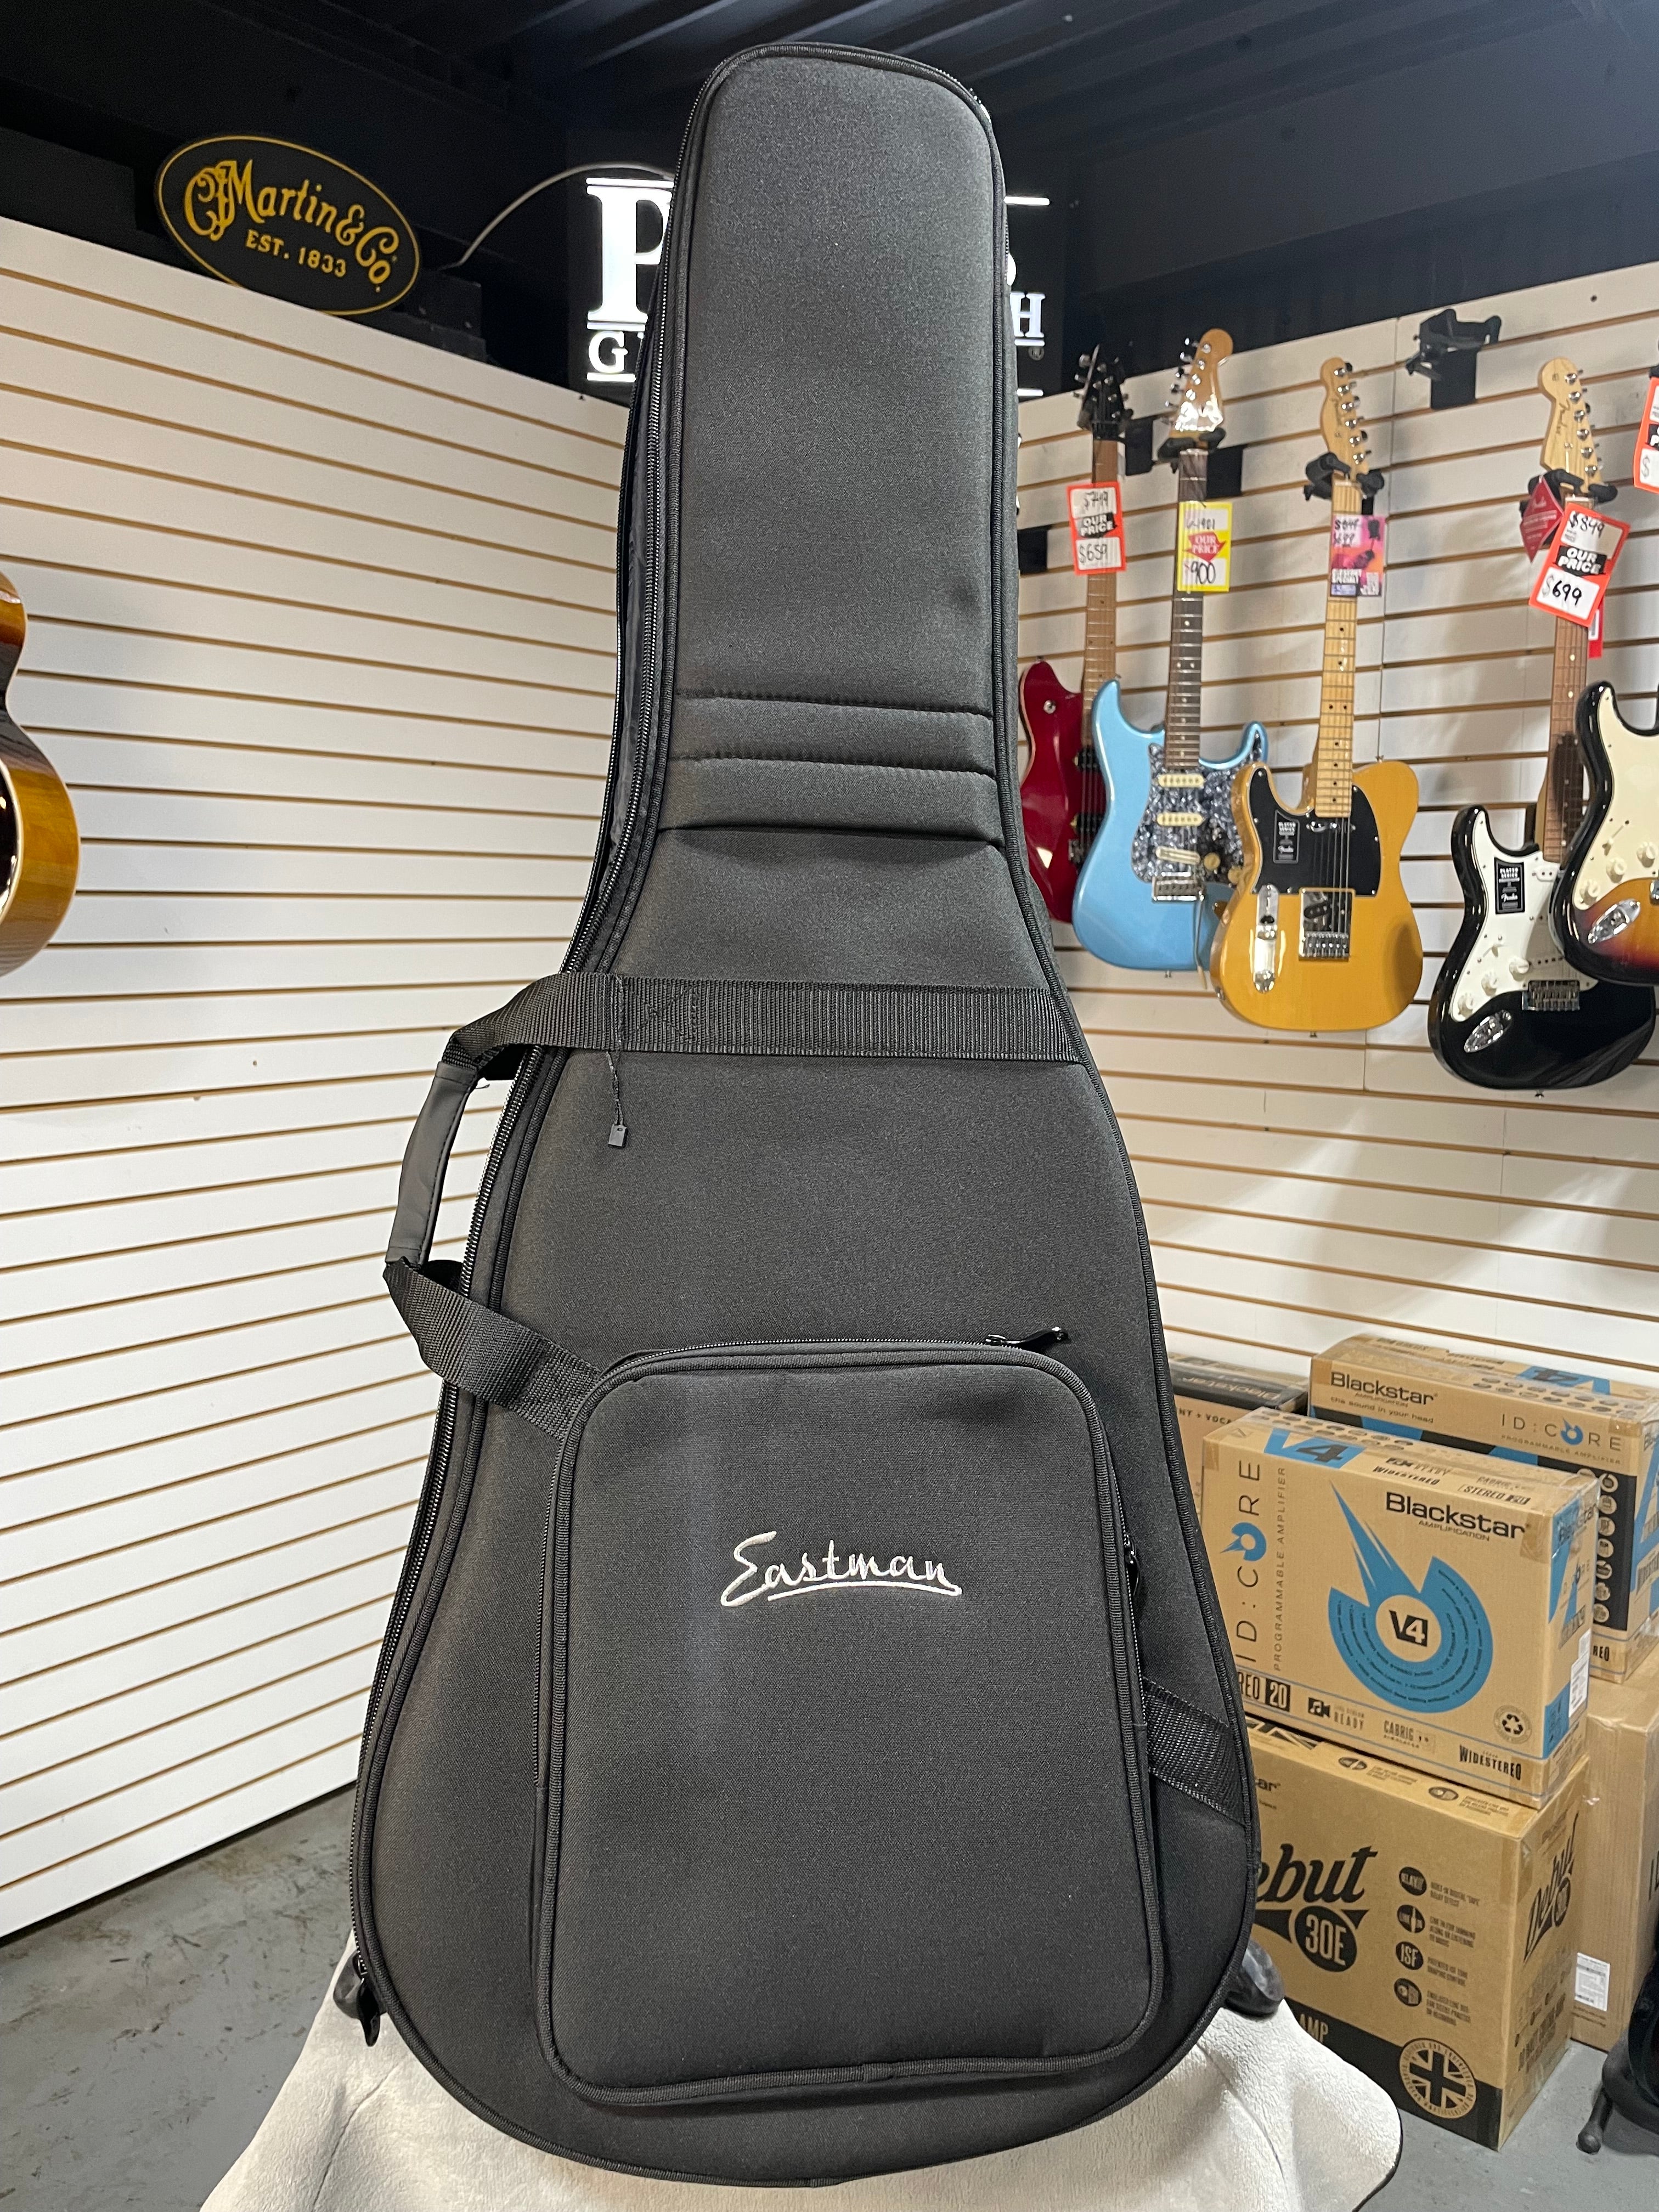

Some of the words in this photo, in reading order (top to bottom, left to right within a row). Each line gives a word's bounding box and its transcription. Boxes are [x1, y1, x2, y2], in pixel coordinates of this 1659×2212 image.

[246, 229, 289, 259] EST.
[298, 247, 347, 278] 1833
[1558, 555, 1602, 575] PRICE
[1566, 548, 1598, 563] OUR
[1542, 574, 1582, 606] $699
[1331, 1372, 1434, 1406] Blackstar
[1348, 1401, 1375, 1412] sound
[1389, 1409, 1409, 1418] your
[1412, 1413, 1434, 1424] head
[1277, 1466, 1286, 1545] AMPLIFIER
[1386, 1492, 1526, 1539] Blackstar
[720, 1530, 963, 1607] Eastman
[1273, 1550, 1285, 1673] PROGRAMMABLE
[1269, 1681, 1288, 1708] 20
[1459, 1743, 1521, 1781] WIDESTEREO
[1305, 1914, 1347, 1966] 30E
[1401, 1944, 1419, 1967] ISF
[1299, 2013, 1329, 2043] AMP
